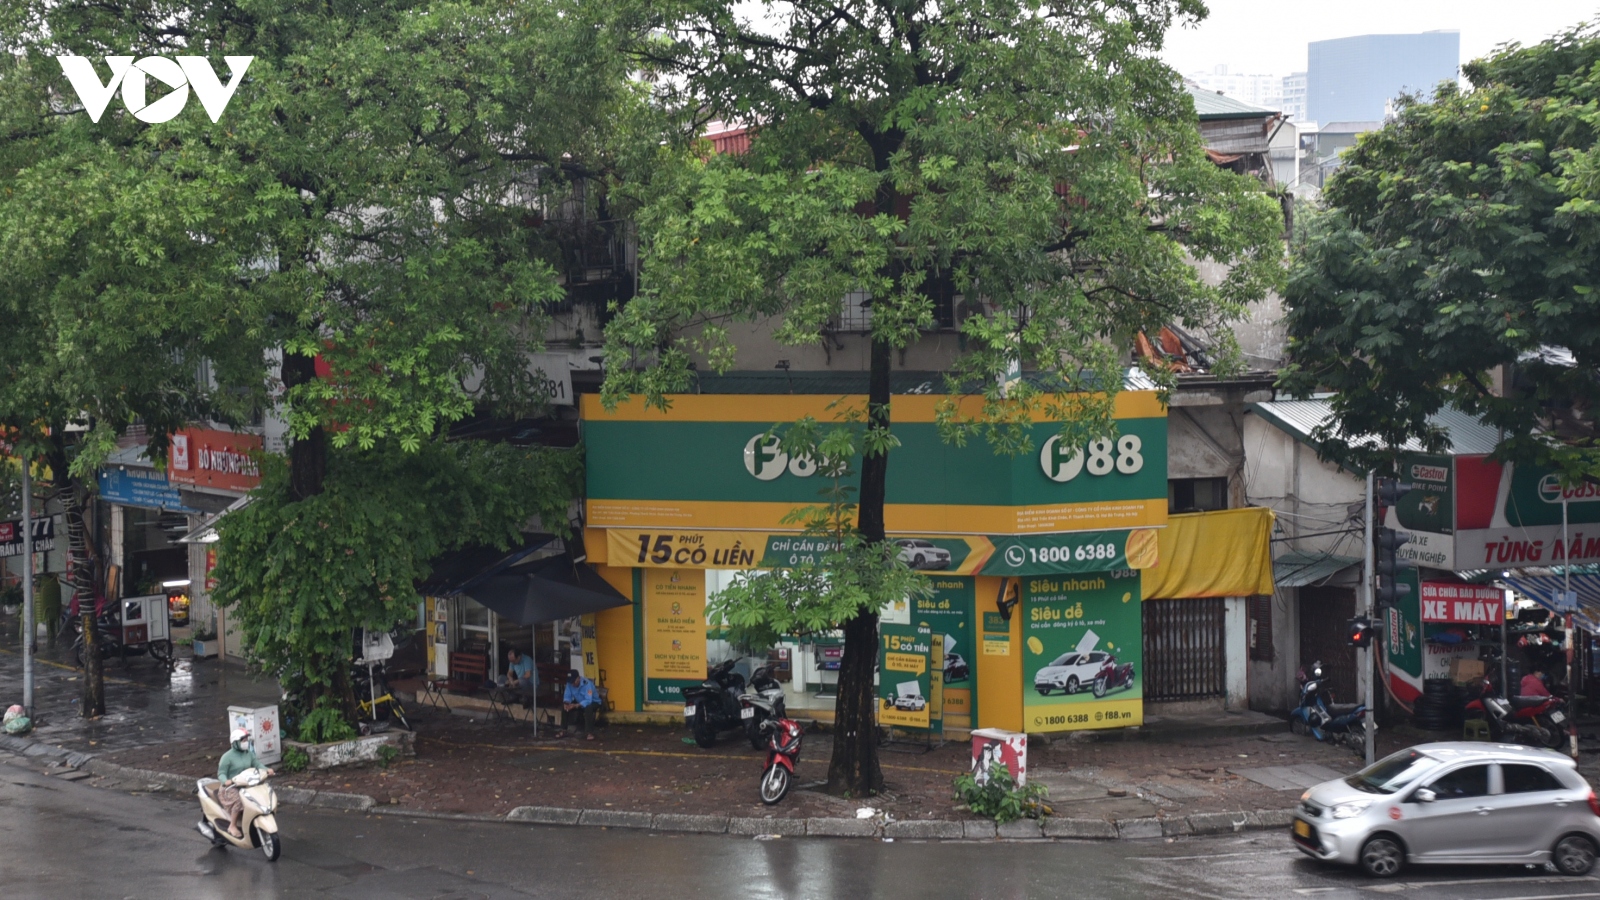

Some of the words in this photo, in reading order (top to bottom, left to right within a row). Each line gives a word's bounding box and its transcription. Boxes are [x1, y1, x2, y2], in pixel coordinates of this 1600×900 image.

[1040, 433, 1144, 482] F88
[1420, 467, 1445, 480] Castrol
[1412, 482, 1426, 490] BIKE
[1428, 484, 1448, 493] POINT
[772, 538, 791, 551] CHỈ
[793, 538, 814, 552] CẦN
[1419, 536, 1428, 546] XE
[638, 534, 673, 565] 15
[679, 534, 704, 544] PHÚT
[674, 543, 707, 565] CÓ
[713, 540, 755, 566] LIỀN
[1029, 544, 1070, 563] 1800
[1075, 543, 1116, 561] 6388
[1485, 536, 1543, 564] TÙNG
[1419, 551, 1446, 564] NGHIỆP
[937, 581, 964, 589] nhanh
[1030, 579, 1058, 593] Siêu
[1063, 577, 1105, 591] nhanh
[1423, 585, 1437, 596] SỬA
[1438, 586, 1458, 598] CHỮA
[1031, 606, 1060, 621] Siêu
[1065, 602, 1083, 619] dễ
[1423, 600, 1448, 619] XE
[1454, 599, 1499, 621] MÁY
[883, 635, 900, 650] 15
[901, 643, 912, 651] CÓ
[914, 642, 929, 652] TIỀN
[586, 651, 594, 665] XE
[1044, 715, 1065, 725] 1800
[1067, 714, 1088, 723] 6388
[1105, 711, 1131, 719] f88.vn
